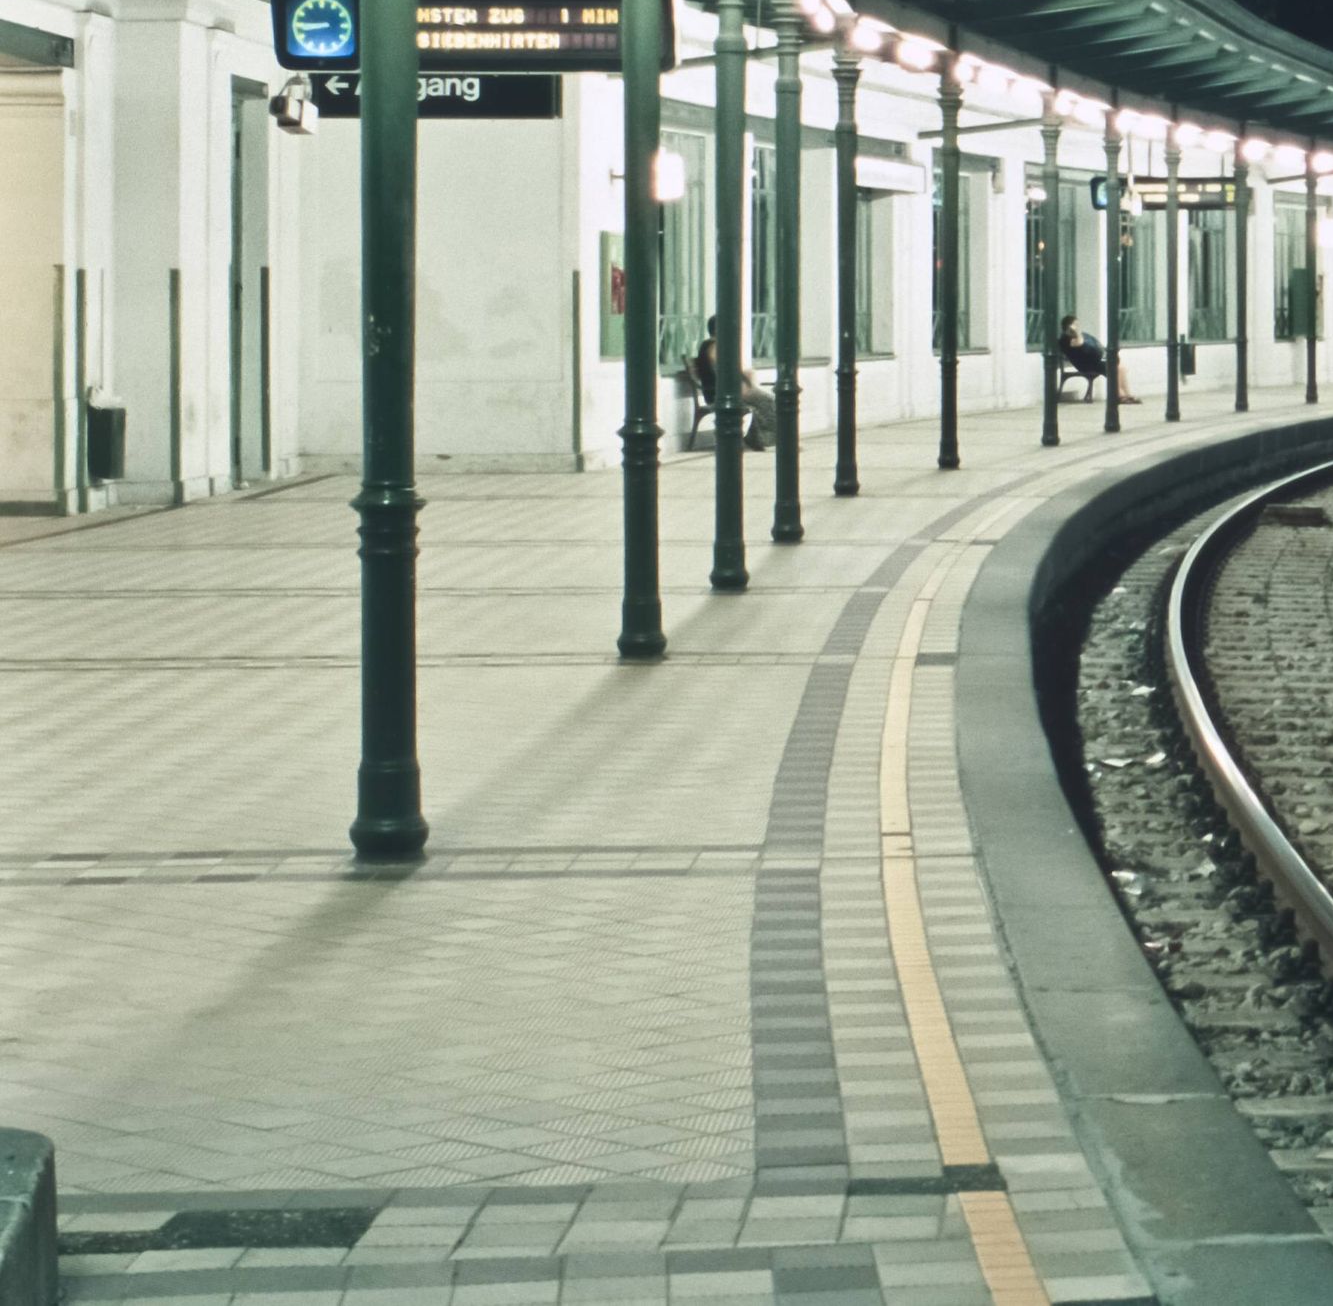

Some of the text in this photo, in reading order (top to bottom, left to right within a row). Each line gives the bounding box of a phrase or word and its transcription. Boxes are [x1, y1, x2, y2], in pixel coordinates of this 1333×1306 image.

[488, 7, 525, 25] ZUG
[582, 8, 619, 25] MIN
[416, 31, 560, 49] SIEBENHIRTEN
